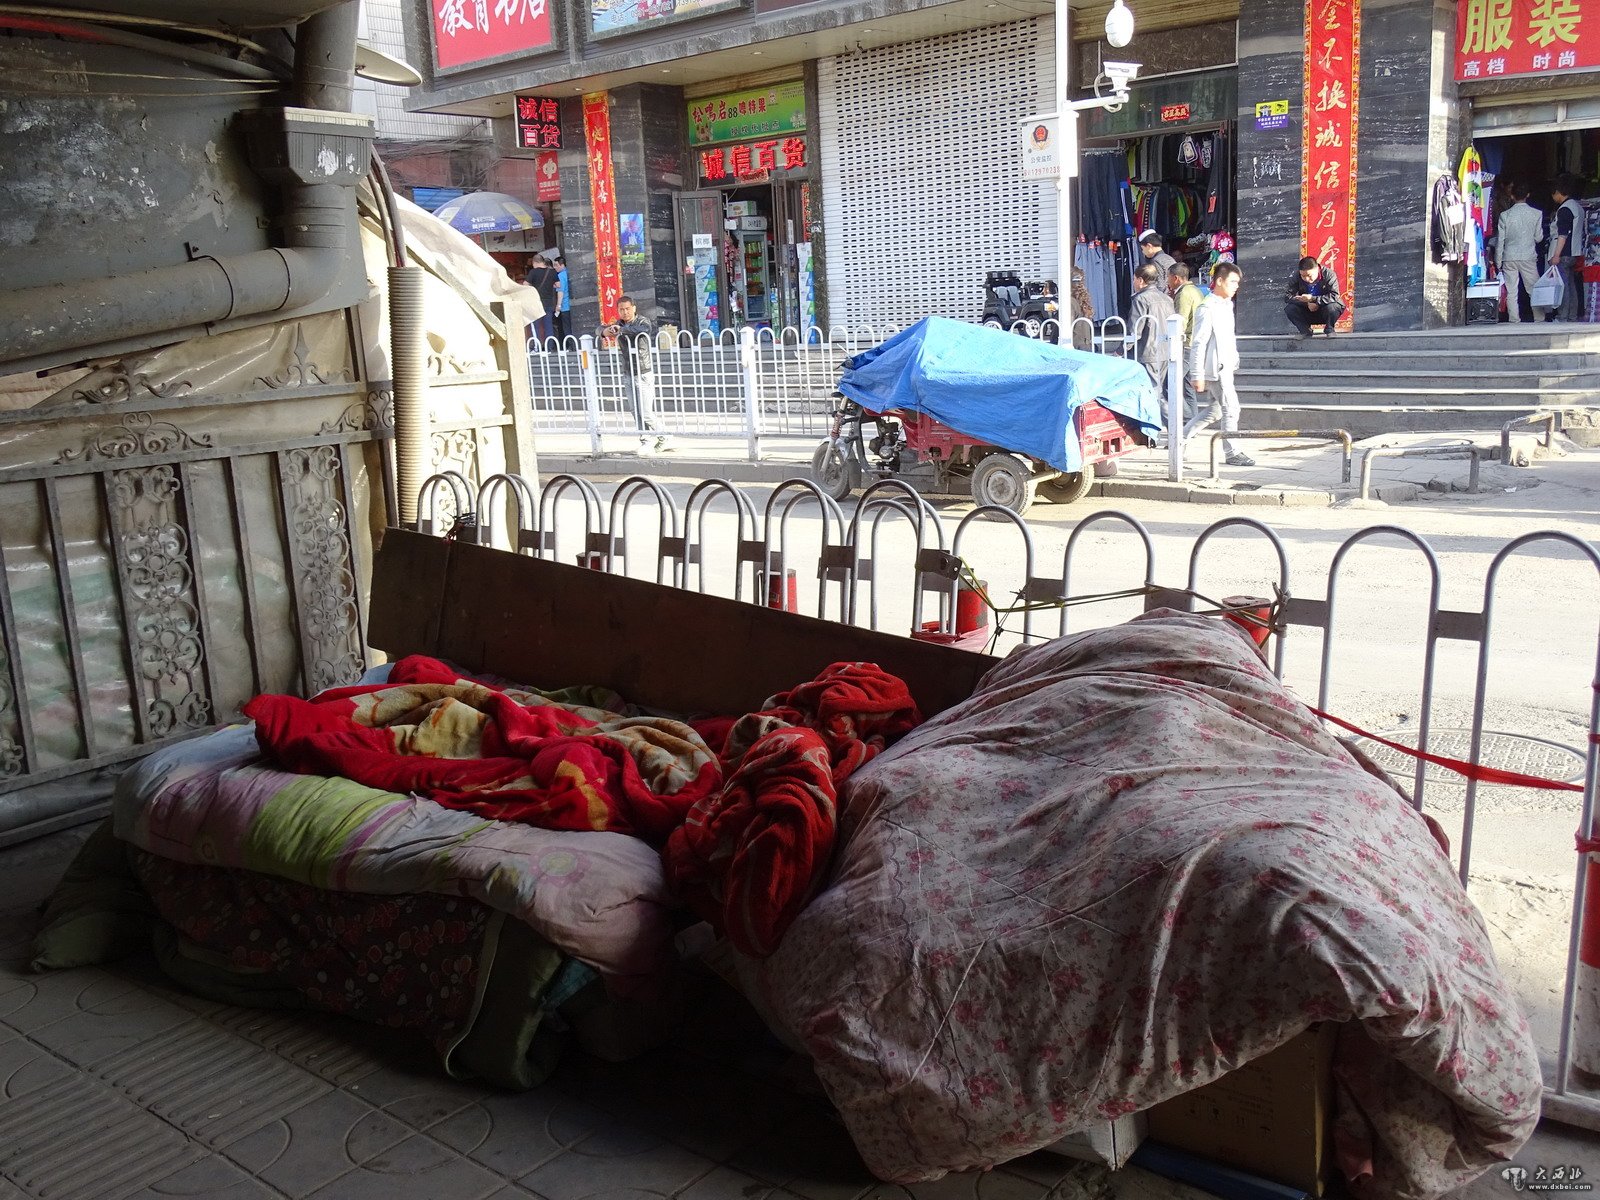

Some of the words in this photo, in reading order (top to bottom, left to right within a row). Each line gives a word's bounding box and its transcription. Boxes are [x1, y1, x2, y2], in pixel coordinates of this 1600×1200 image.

[1461, 0, 1582, 55] 服装
[1464, 58, 1506, 77] 高档
[1532, 50, 1576, 70] 时尚
[518, 97, 559, 122] 诚信
[520, 124, 561, 148] 百货
[701, 138, 805, 181] 诚信百货
